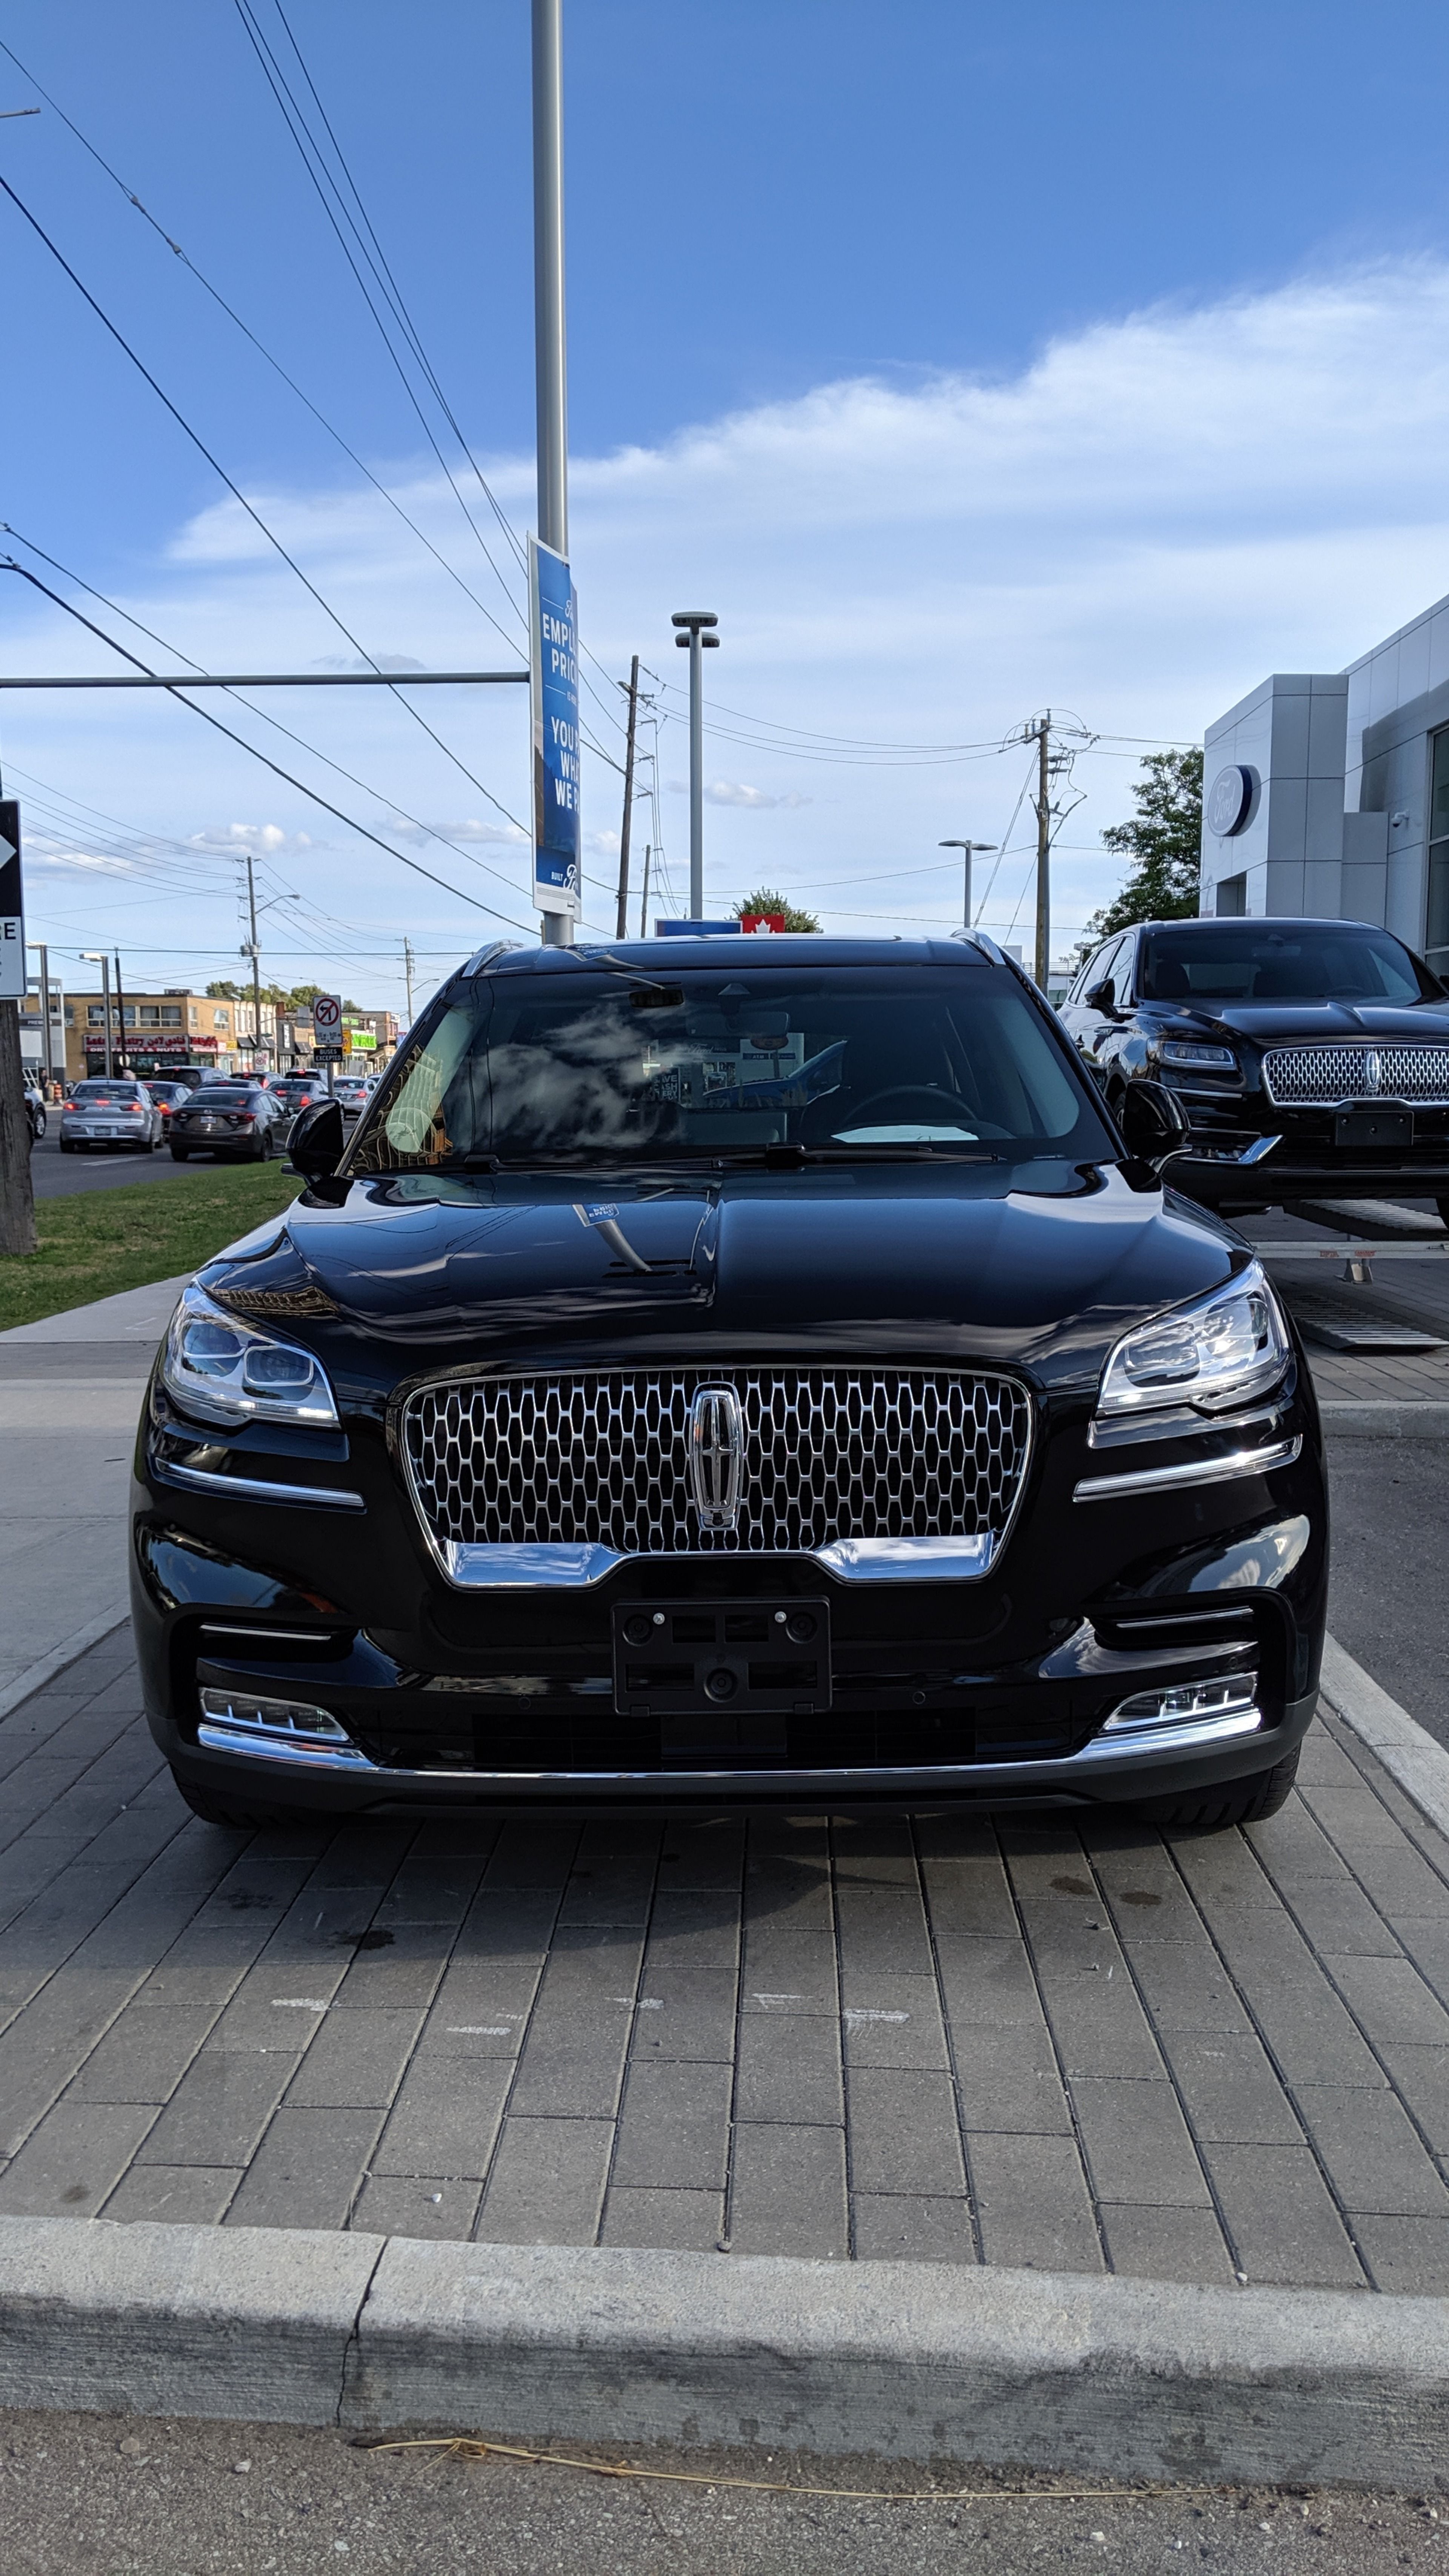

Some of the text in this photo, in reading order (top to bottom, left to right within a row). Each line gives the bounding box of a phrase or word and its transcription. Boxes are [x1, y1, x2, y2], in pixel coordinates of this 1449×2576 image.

[551, 716, 573, 751] YOU
[555, 778, 572, 809] WE
[1214, 779, 1235, 823] Ford
[551, 871, 563, 881] BUILT
